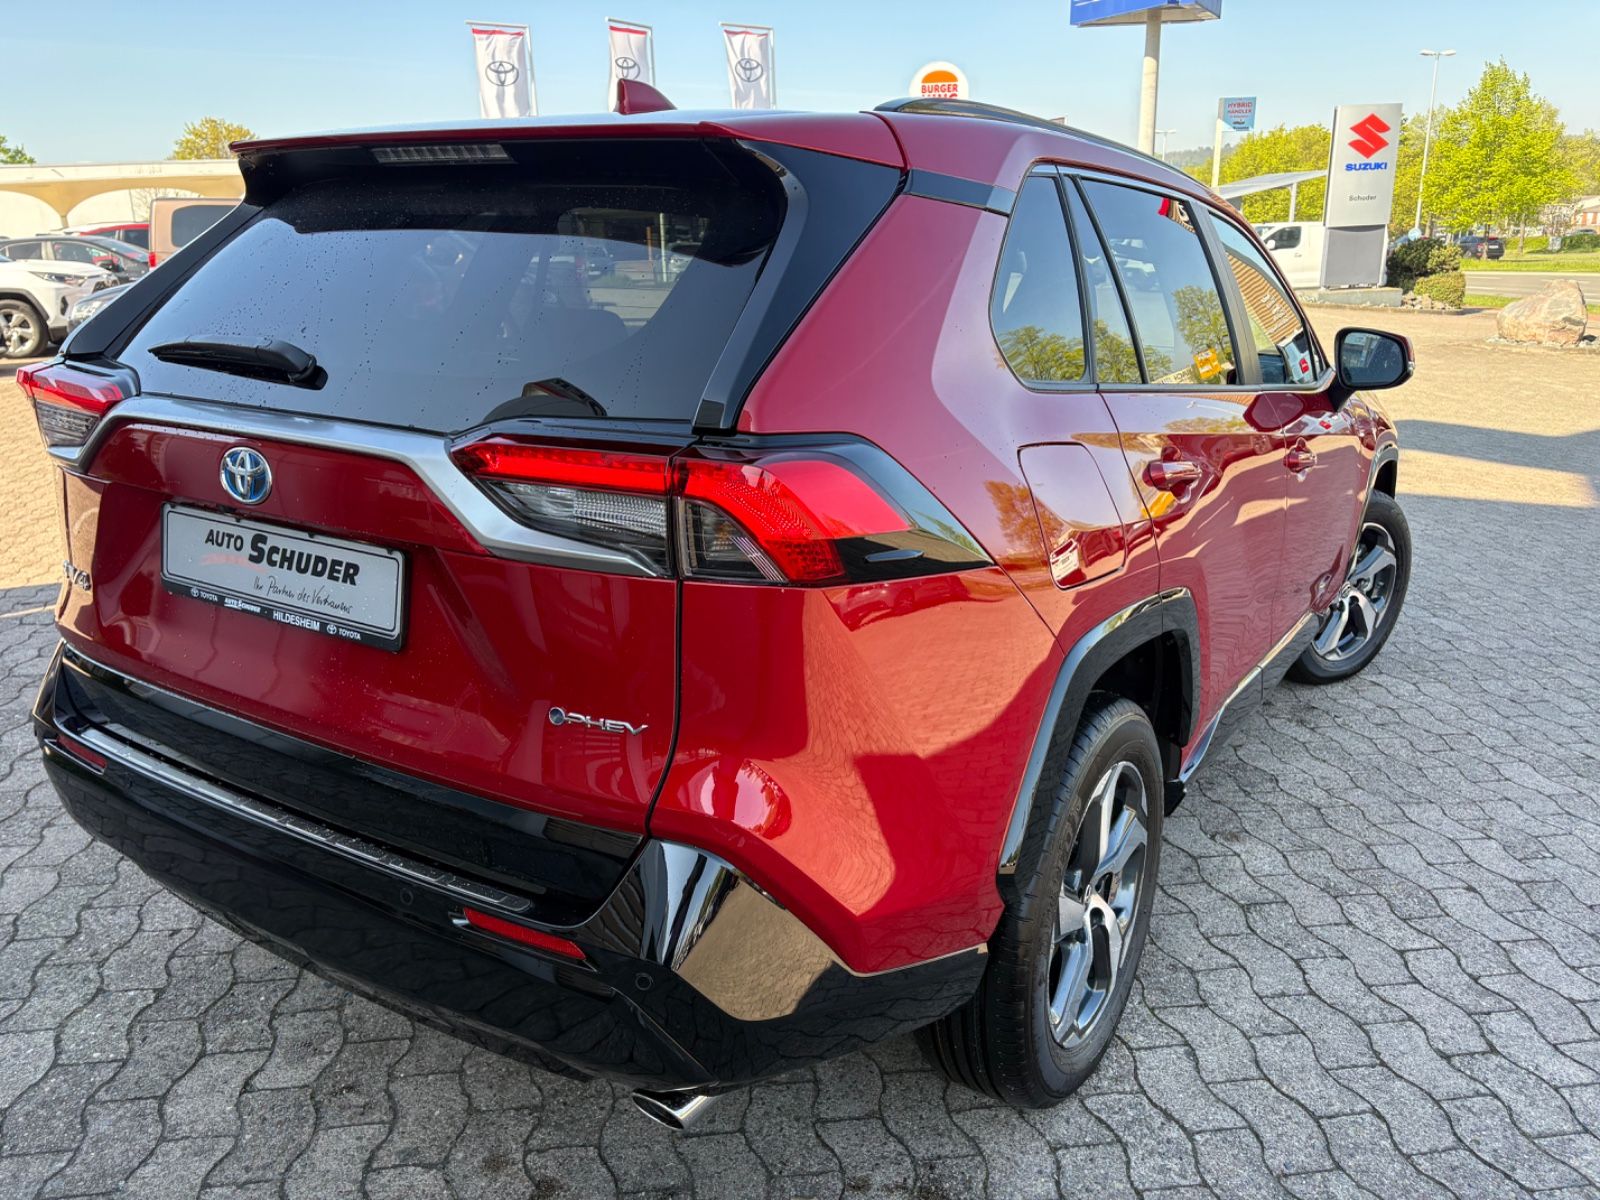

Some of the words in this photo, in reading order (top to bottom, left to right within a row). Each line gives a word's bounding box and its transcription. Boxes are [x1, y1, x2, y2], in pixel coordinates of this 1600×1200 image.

[921, 84, 958, 93] BURGER
[1345, 162, 1388, 171] SUZUKI
[205, 529, 244, 551] AUTO
[248, 533, 361, 586] SCHUDER
[273, 610, 320, 631] HILDESHEIM
[339, 628, 361, 640] TOYOTA
